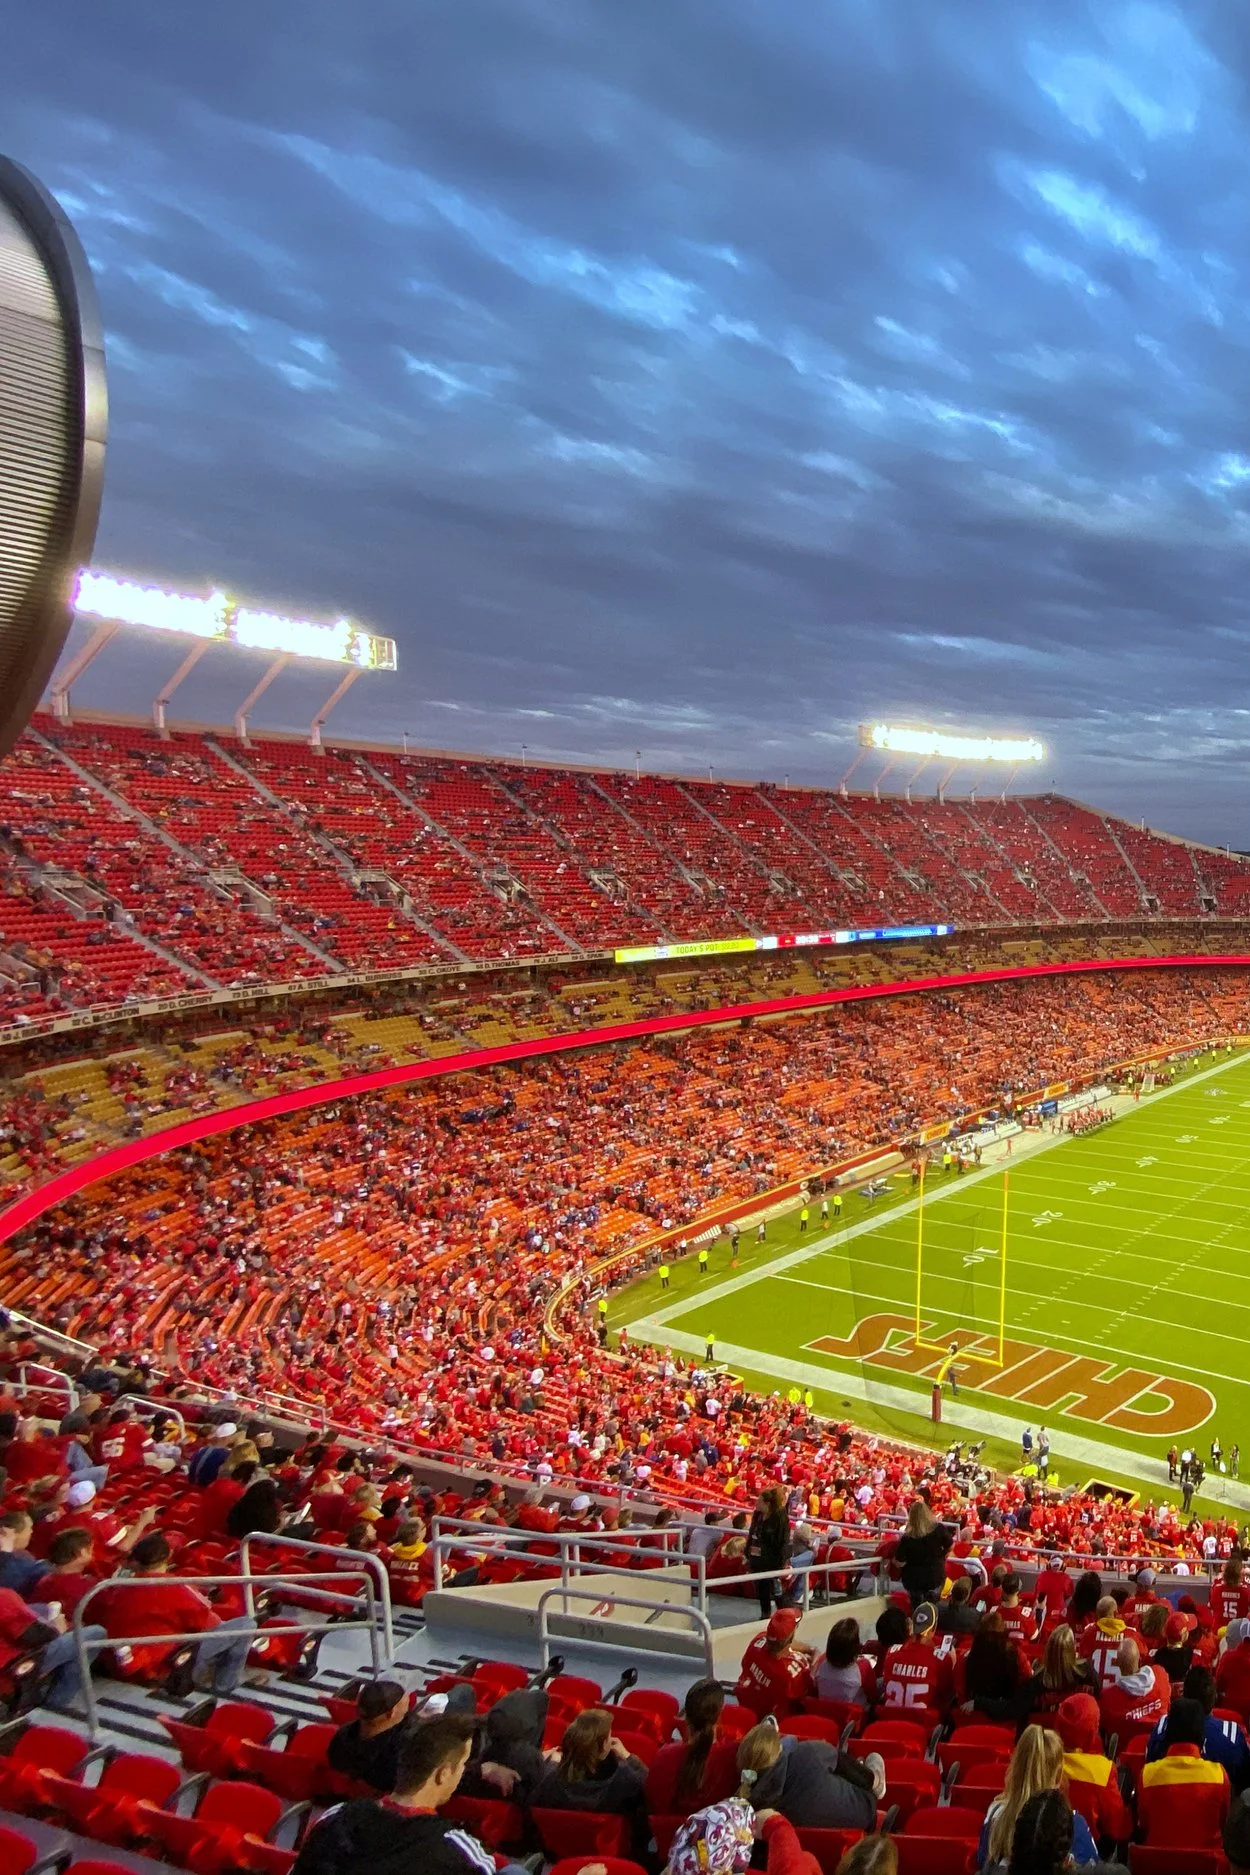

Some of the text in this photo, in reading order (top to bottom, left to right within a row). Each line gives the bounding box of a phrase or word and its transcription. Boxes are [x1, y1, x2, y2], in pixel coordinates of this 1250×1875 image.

[1032, 1210, 1064, 1226] 20
[963, 1246, 999, 1266] 10
[799, 1312, 1218, 1438] CHIEFS
[1223, 1601, 1238, 1619] 15
[892, 1662, 929, 1679] CHARLES
[1092, 1648, 1121, 1688] 15
